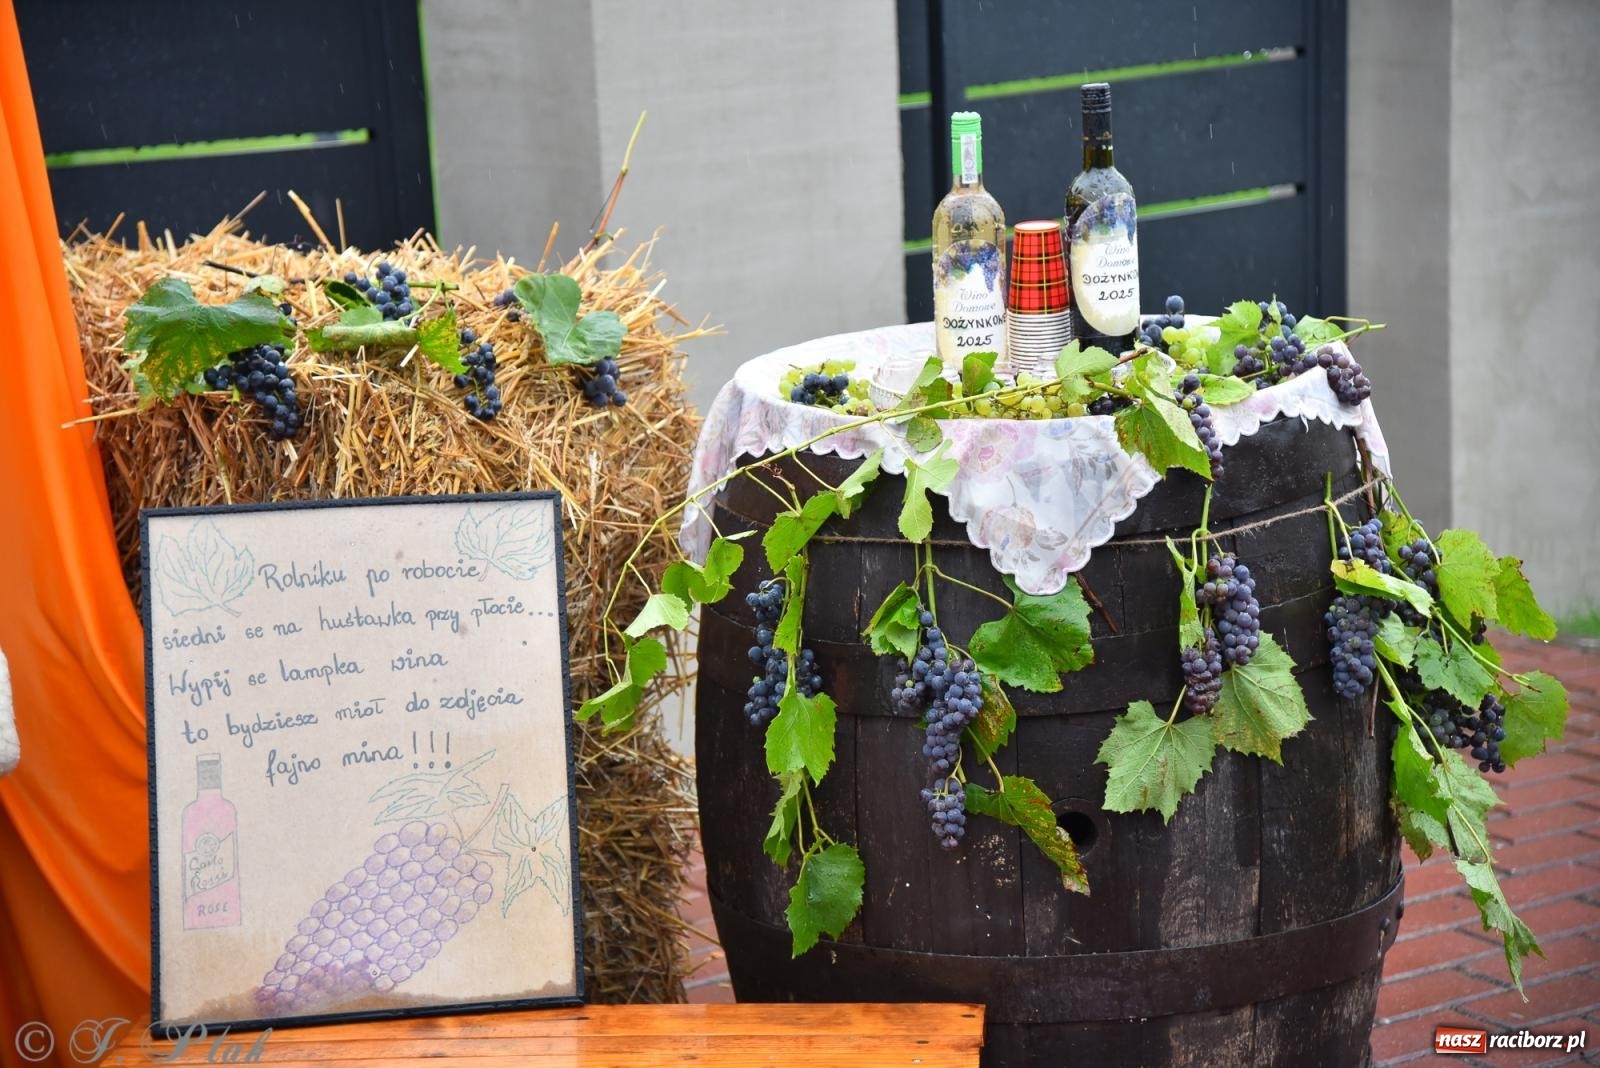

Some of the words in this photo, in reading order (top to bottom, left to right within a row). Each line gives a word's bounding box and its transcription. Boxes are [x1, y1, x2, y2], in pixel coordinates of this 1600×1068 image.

[1098, 288, 1135, 301] 2025
[957, 334, 994, 347] 2025
[259, 561, 347, 592] Rolniku
[366, 570, 390, 597] po
[402, 559, 480, 579] robocie
[162, 625, 226, 650] siedni
[245, 626, 264, 640] se
[273, 620, 303, 636] na
[425, 609, 460, 634] przy
[169, 669, 232, 706] Wypij
[248, 672, 267, 686] se
[279, 653, 365, 686] lampka
[181, 720, 209, 744] to
[226, 713, 319, 748] bydziesz
[405, 691, 430, 713] do
[439, 687, 525, 720] zdjęcia
[265, 749, 322, 786] fajno
[197, 902, 229, 917] ROSE
